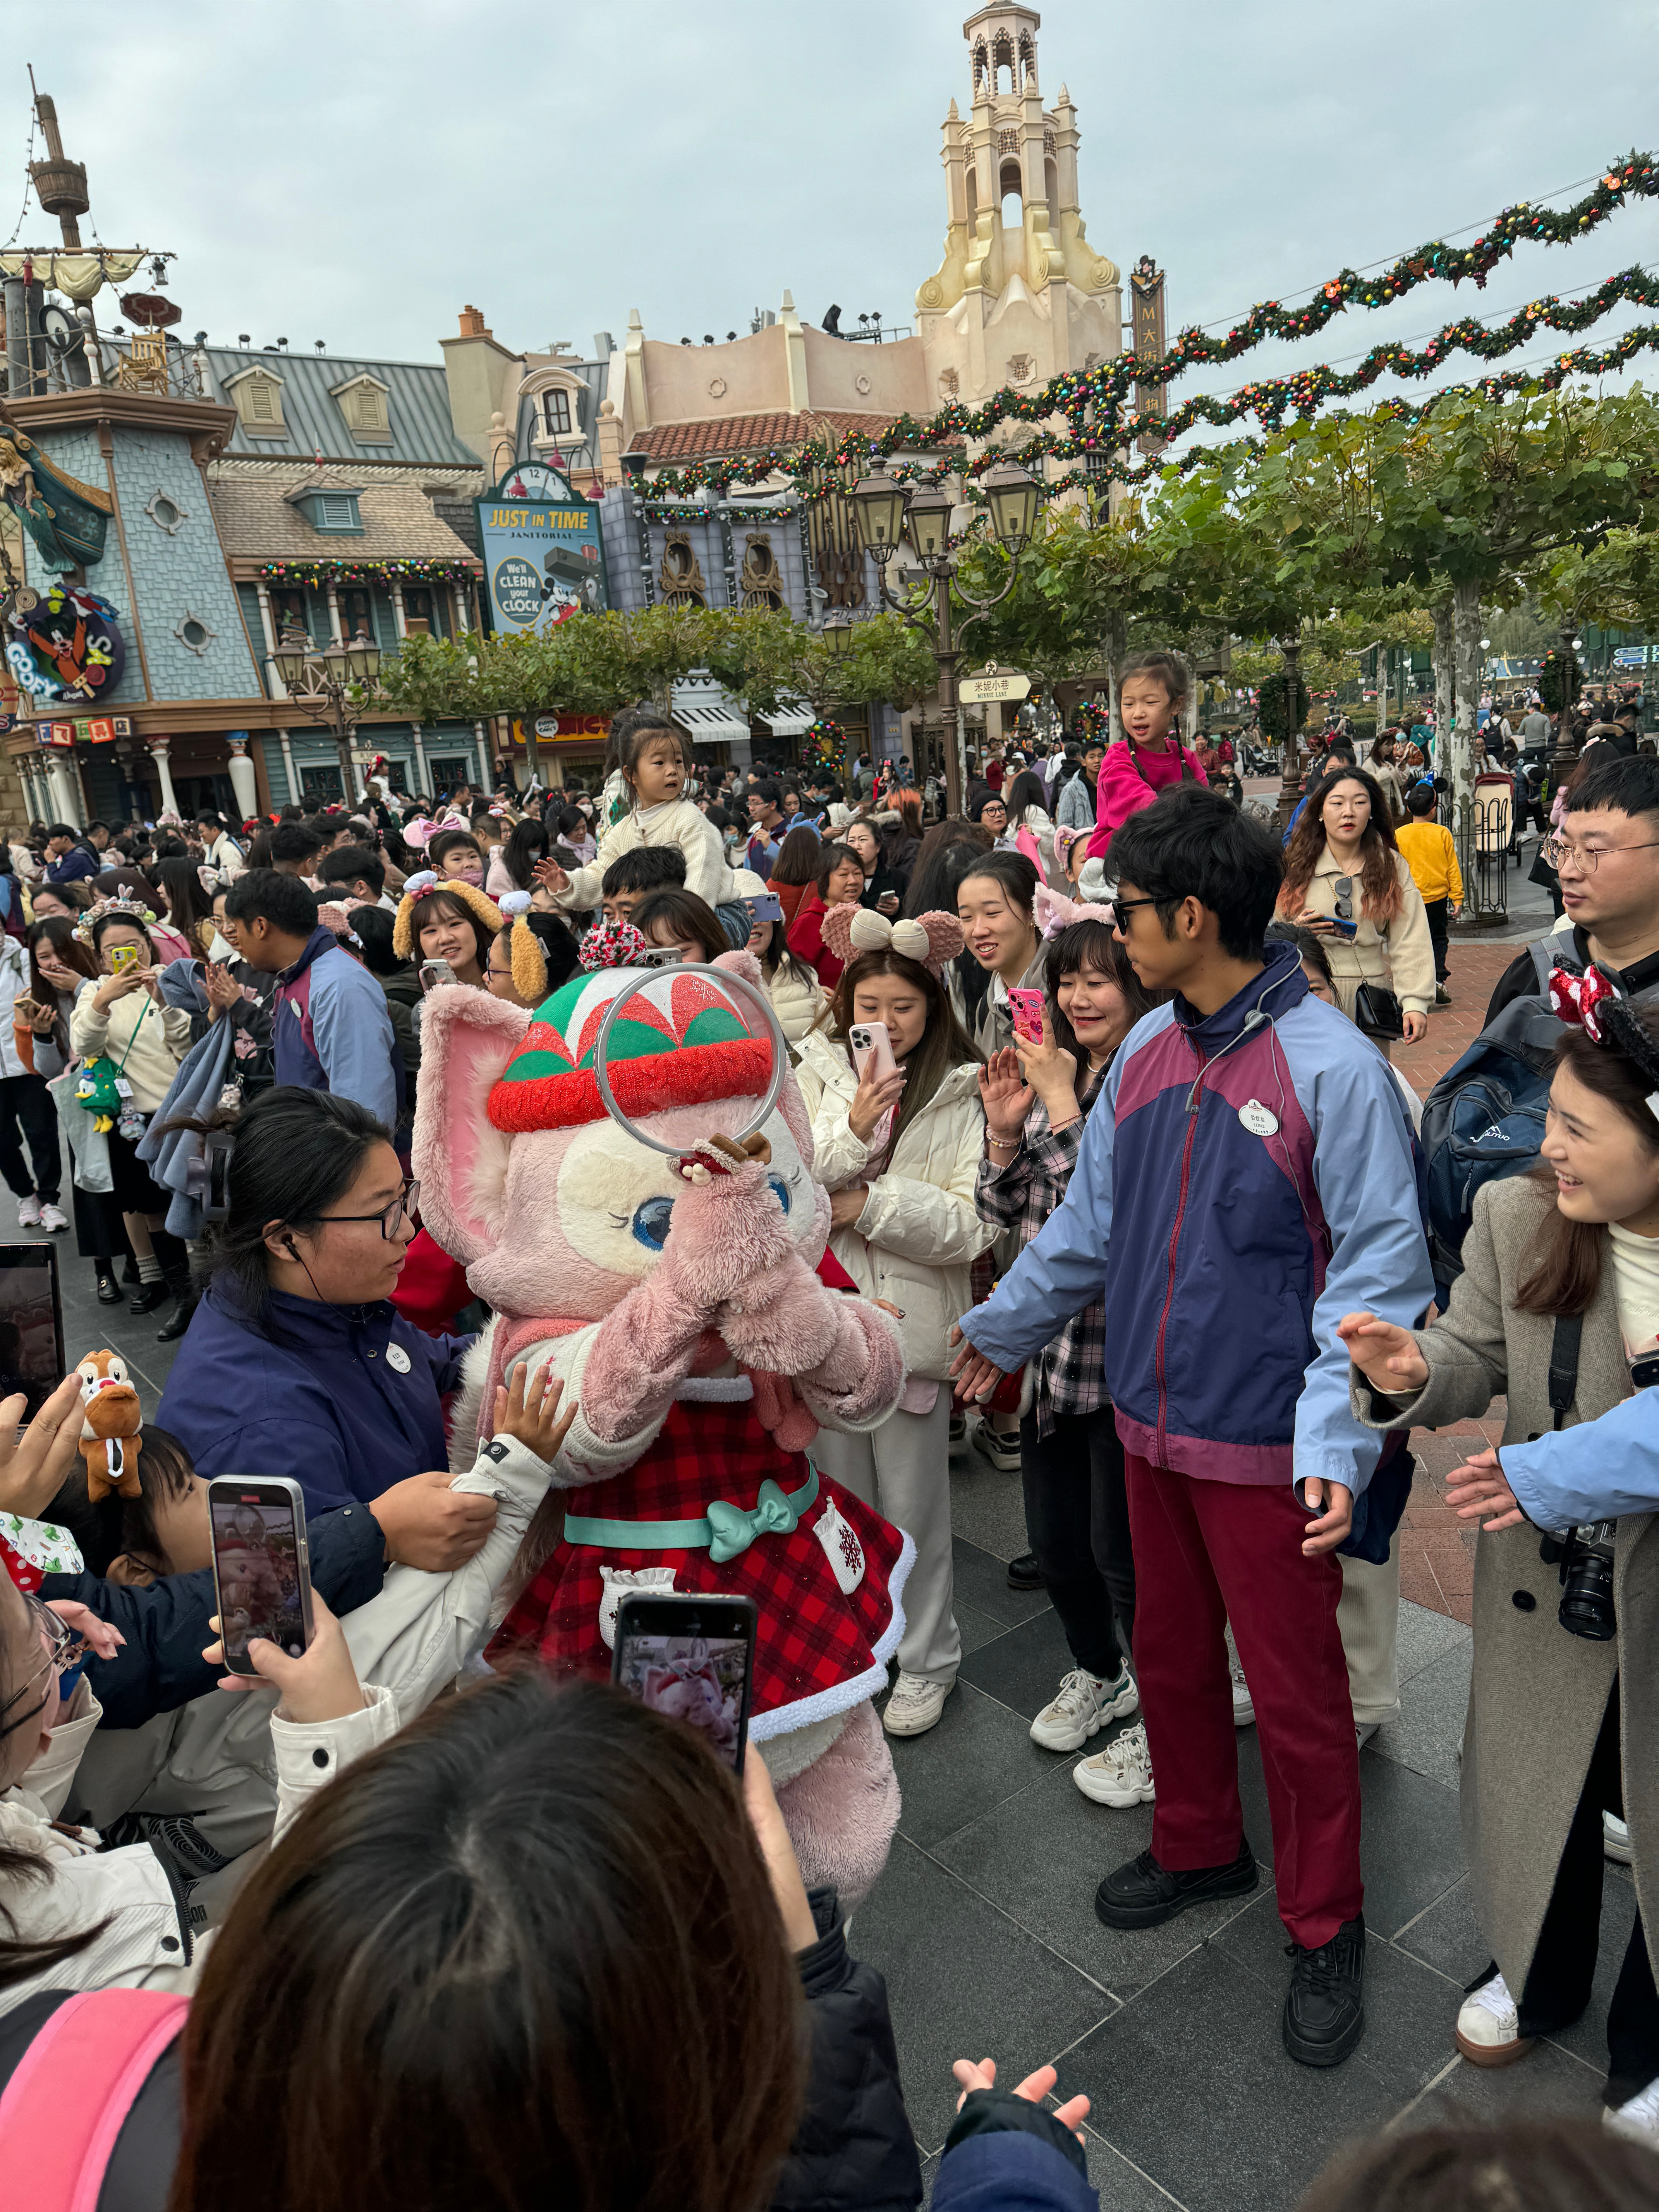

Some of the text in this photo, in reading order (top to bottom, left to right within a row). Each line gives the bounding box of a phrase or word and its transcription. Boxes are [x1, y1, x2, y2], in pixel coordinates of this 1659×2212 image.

[529, 469, 539, 478] 12
[552, 477, 556, 485] 1
[489, 509, 588, 529] JUST IN TIME
[507, 563, 527, 574] We'll
[500, 576, 536, 589] CLEAN
[510, 589, 529, 598] your
[502, 599, 540, 613] CLOCK
[6, 642, 59, 697] GOOFY
[975, 679, 1009, 692] 米妮小巷
